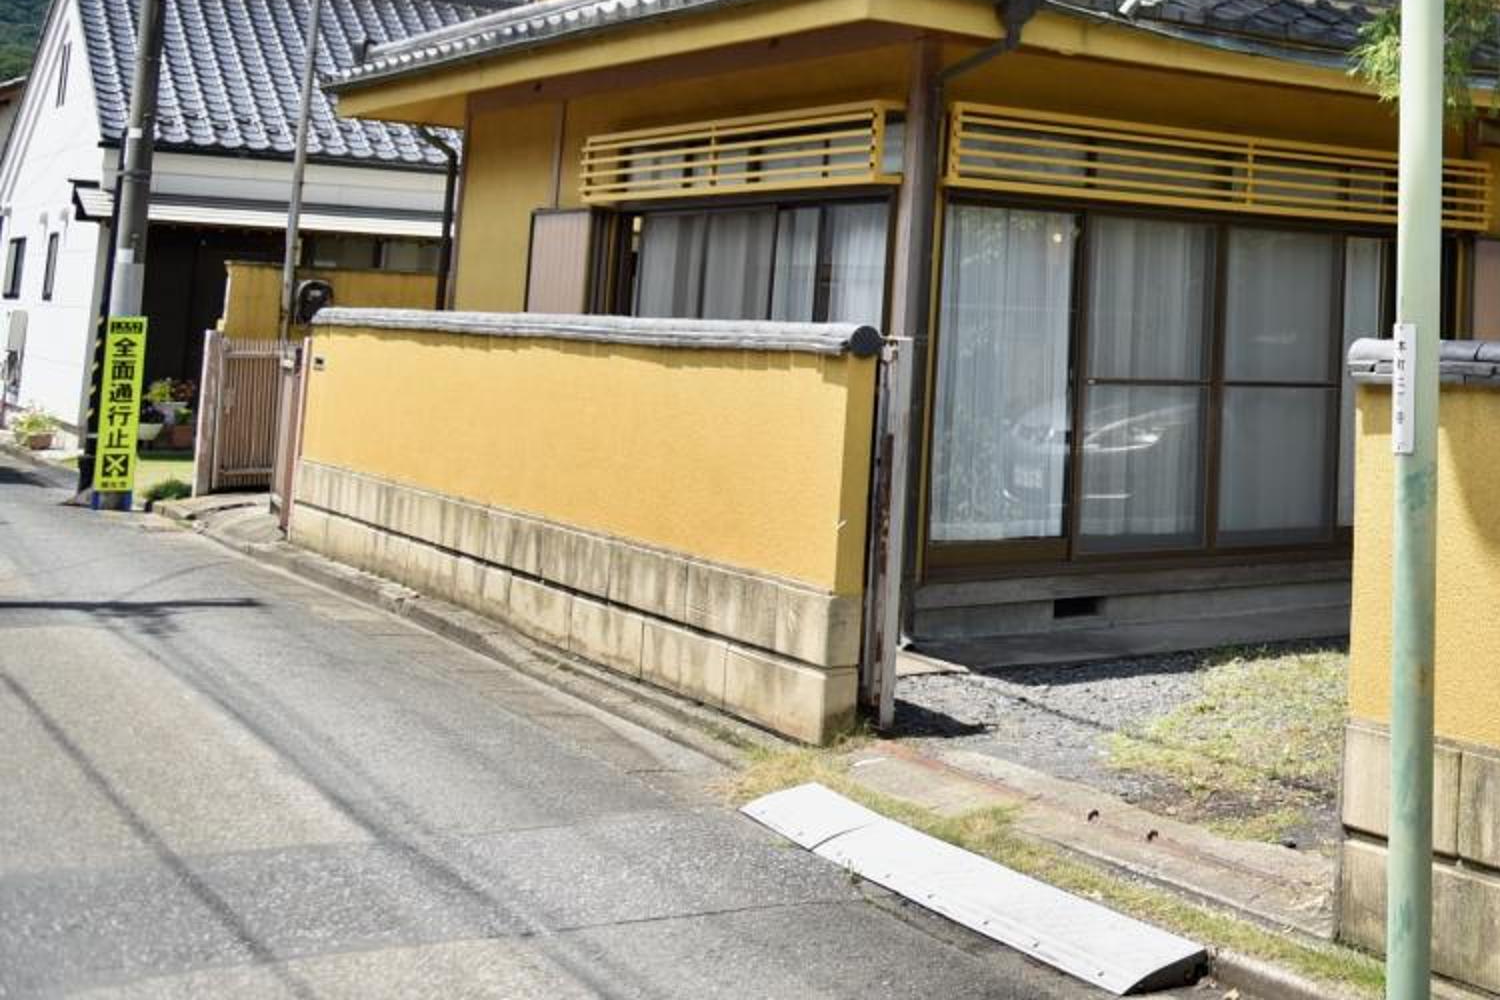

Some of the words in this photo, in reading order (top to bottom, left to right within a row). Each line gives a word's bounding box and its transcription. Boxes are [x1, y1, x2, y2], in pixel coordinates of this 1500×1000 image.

[106, 337, 137, 448] 全面通行止
